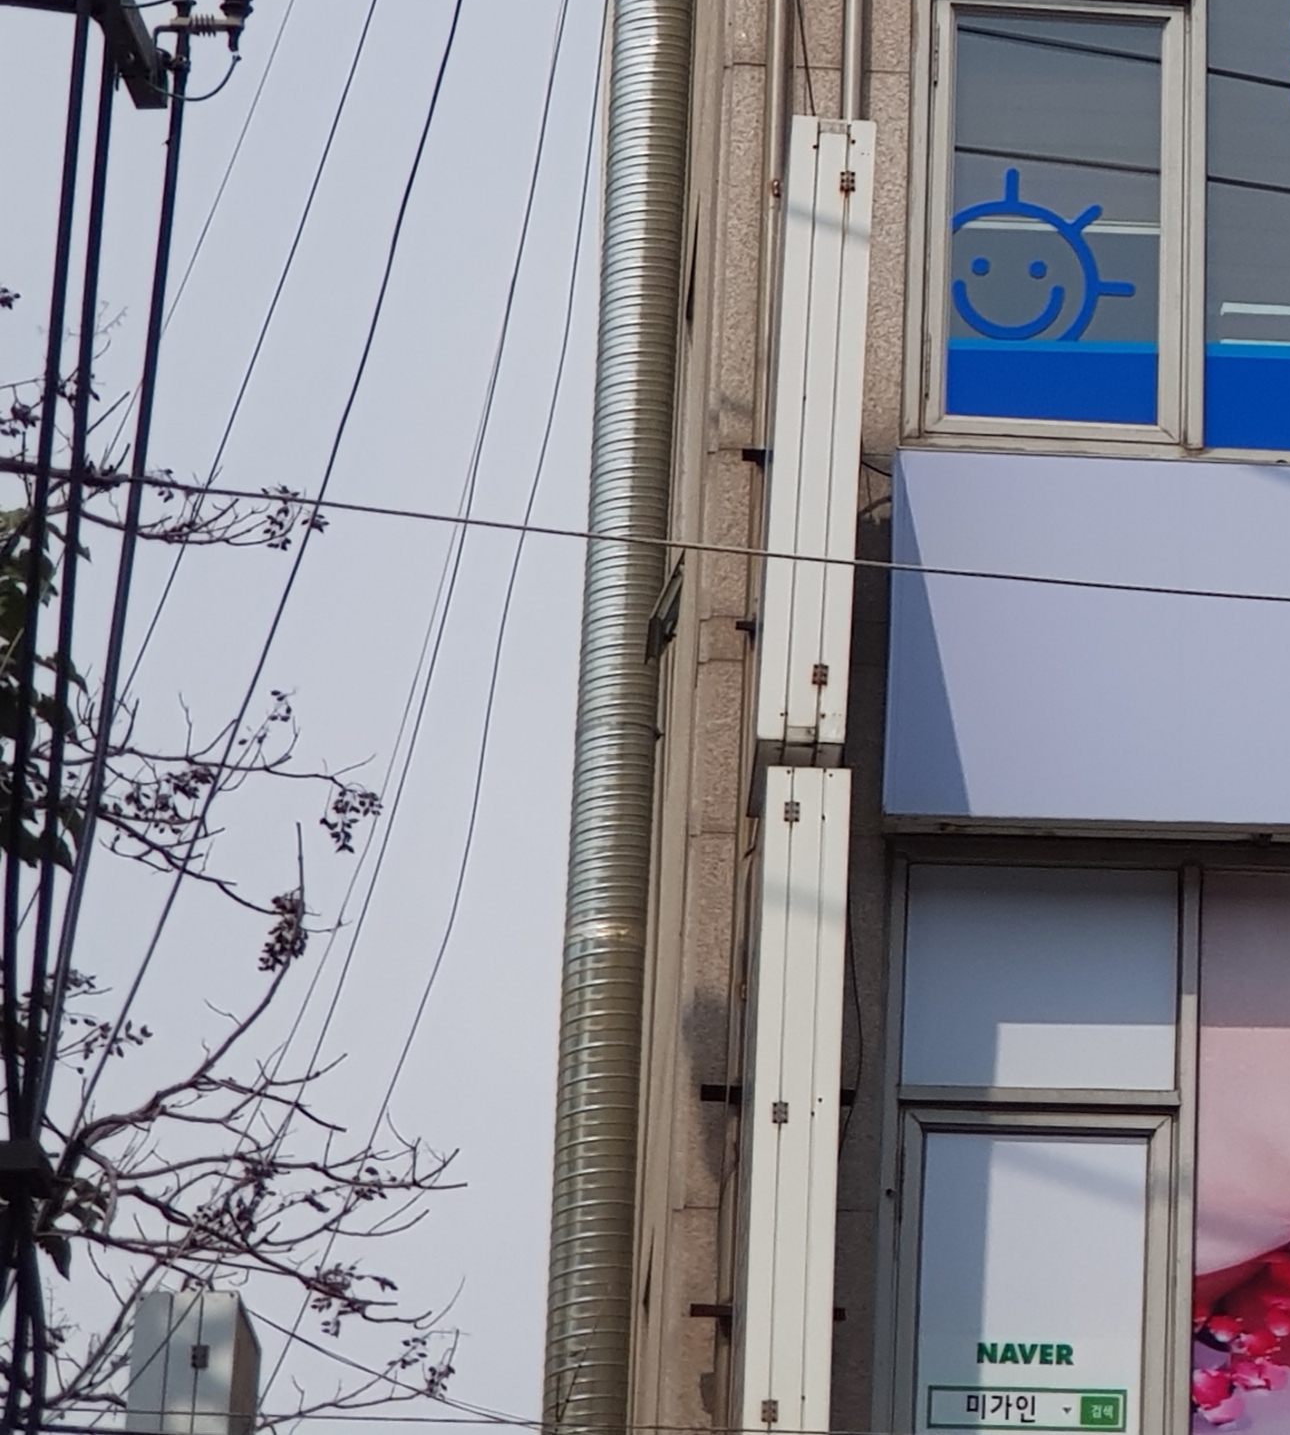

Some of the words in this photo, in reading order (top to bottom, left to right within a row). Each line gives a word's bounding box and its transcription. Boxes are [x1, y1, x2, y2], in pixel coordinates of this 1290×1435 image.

[976, 1342, 1074, 1365] NAVER
[965, 1395, 1037, 1423] 미가인
[1091, 1403, 1115, 1420] 검색
